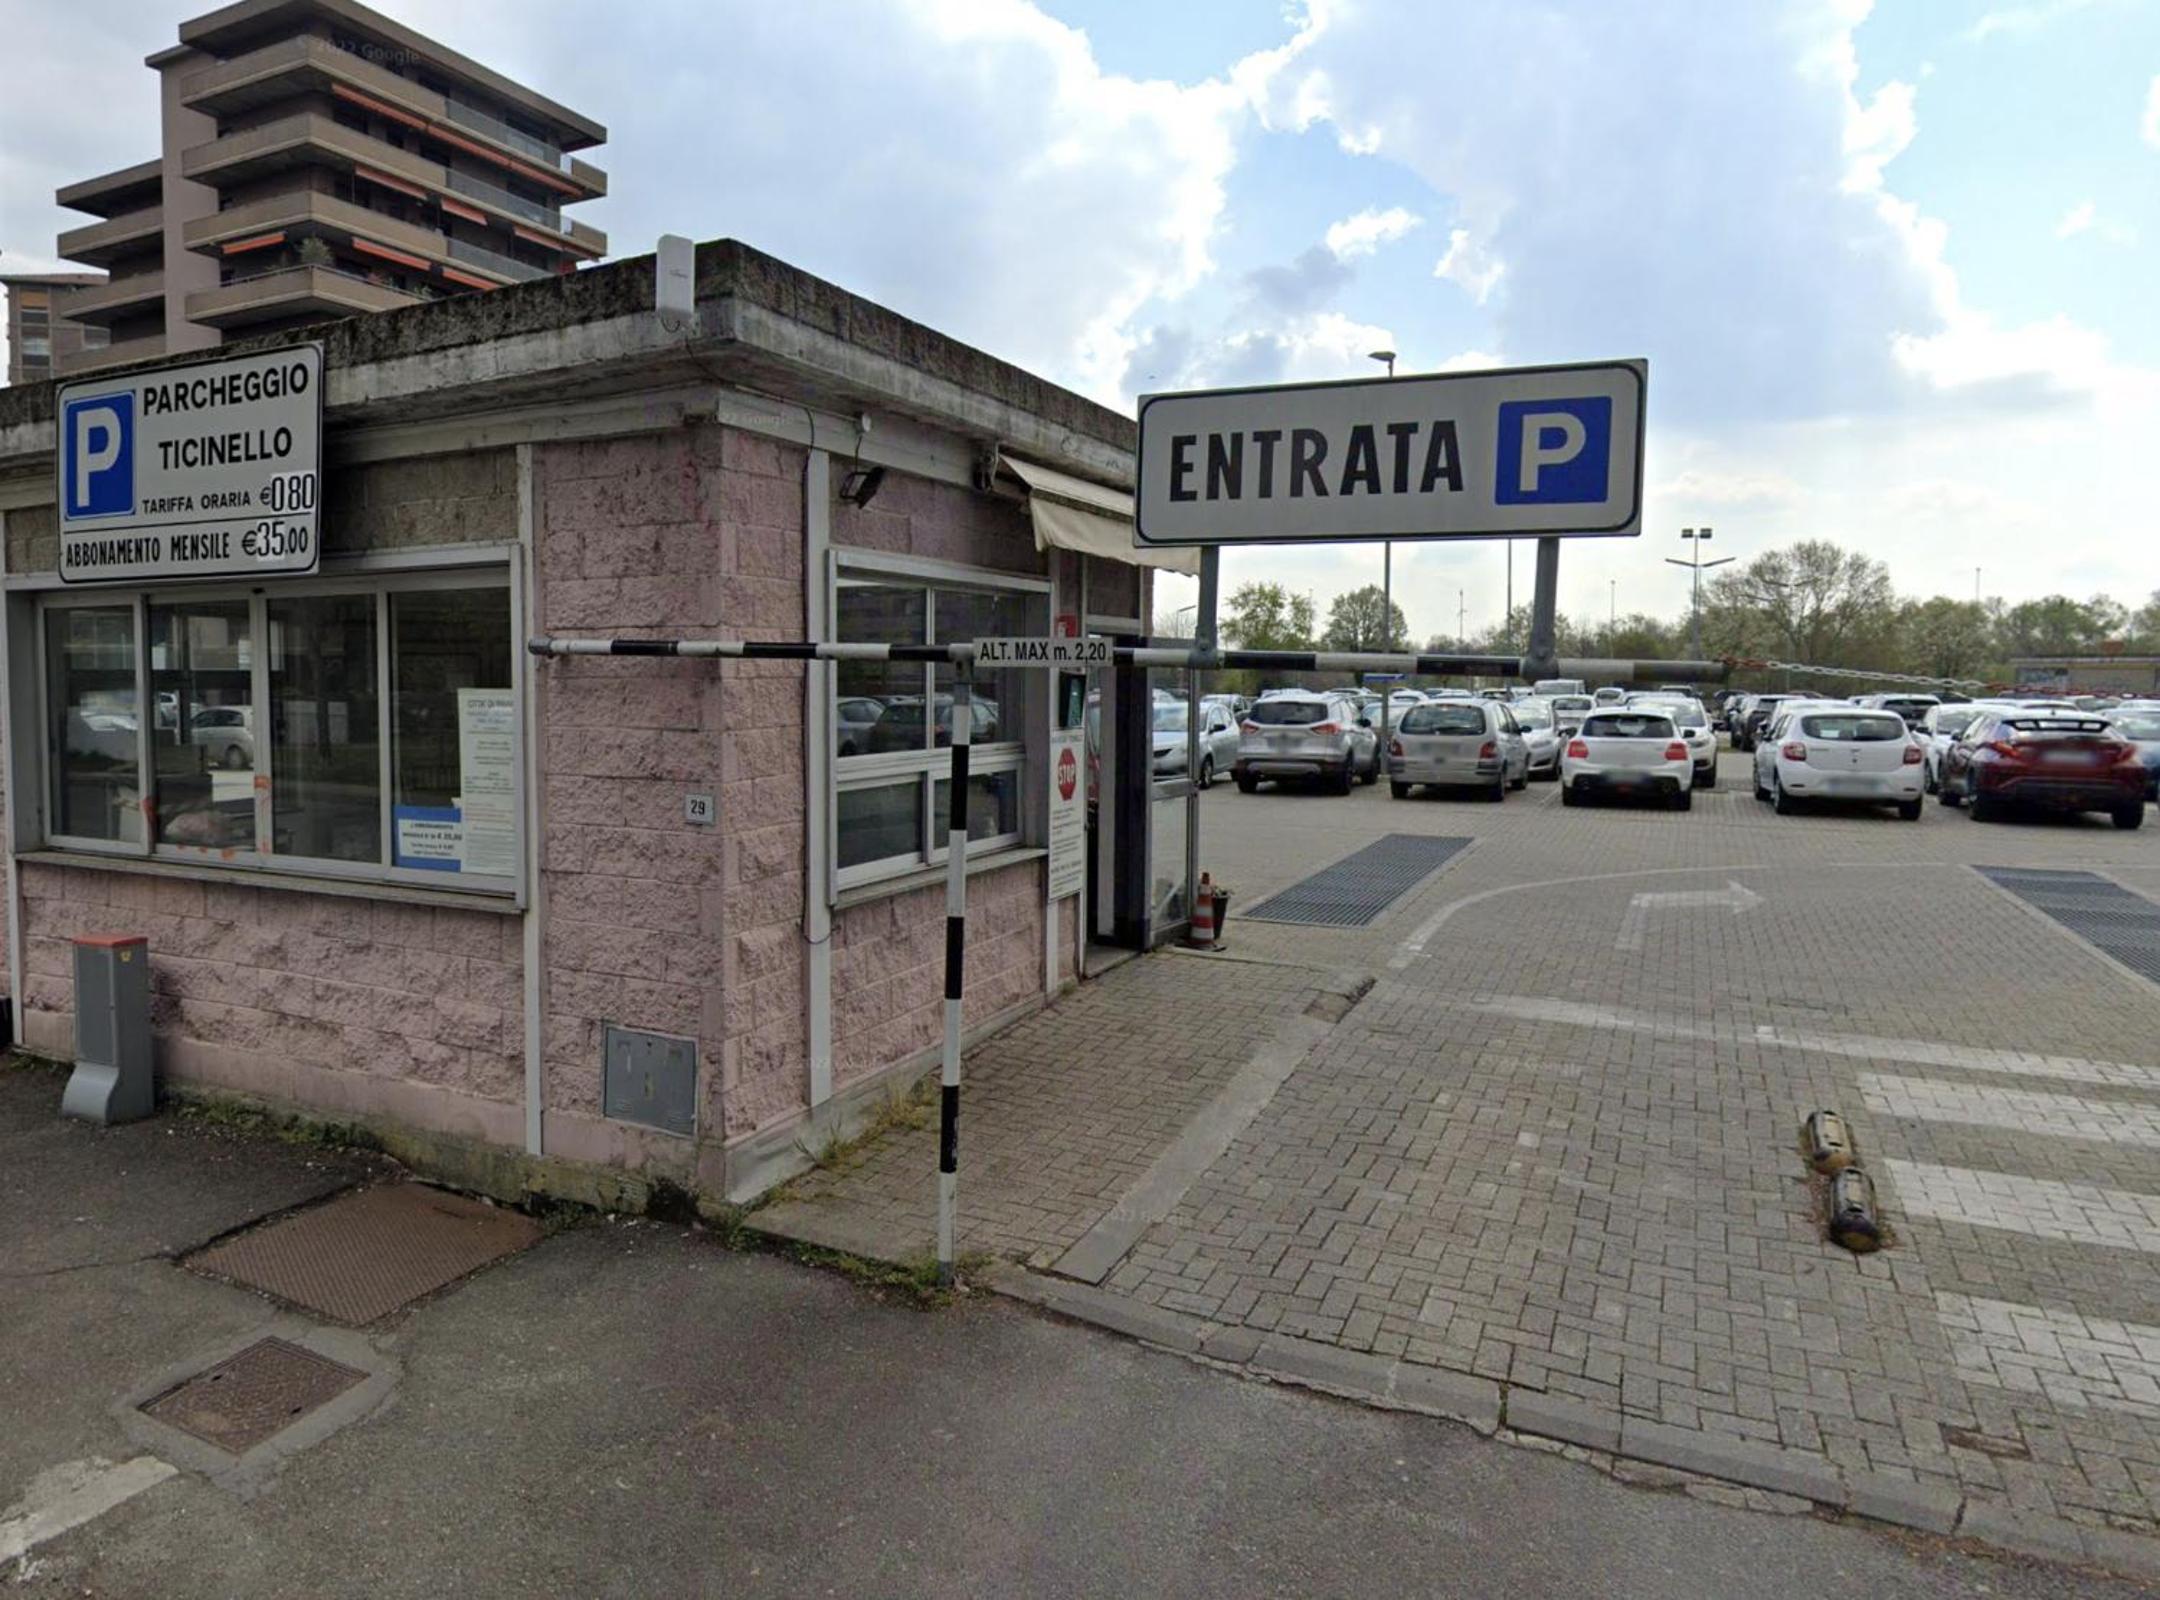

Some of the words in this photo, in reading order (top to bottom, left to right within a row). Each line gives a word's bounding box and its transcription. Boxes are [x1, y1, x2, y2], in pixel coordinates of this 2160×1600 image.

[143, 363, 308, 416] PARCHEGGIO
[77, 406, 121, 508] P
[158, 426, 292, 470] TICINELLO
[1170, 420, 1464, 502] ENTRATA
[1519, 412, 1586, 492] P
[142, 496, 194, 514] TARIFFA
[200, 492, 250, 510] ORARIA
[66, 537, 160, 567] ABBONAMENTO
[170, 533, 230, 562] MENSILE
[980, 642, 1011, 661] ALT.
[1015, 642, 1049, 661] MAX
[1053, 645, 1072, 661] m.
[1075, 642, 1107, 665] 2,20
[1058, 764, 1077, 785] STOP
[691, 800, 705, 815] 29
